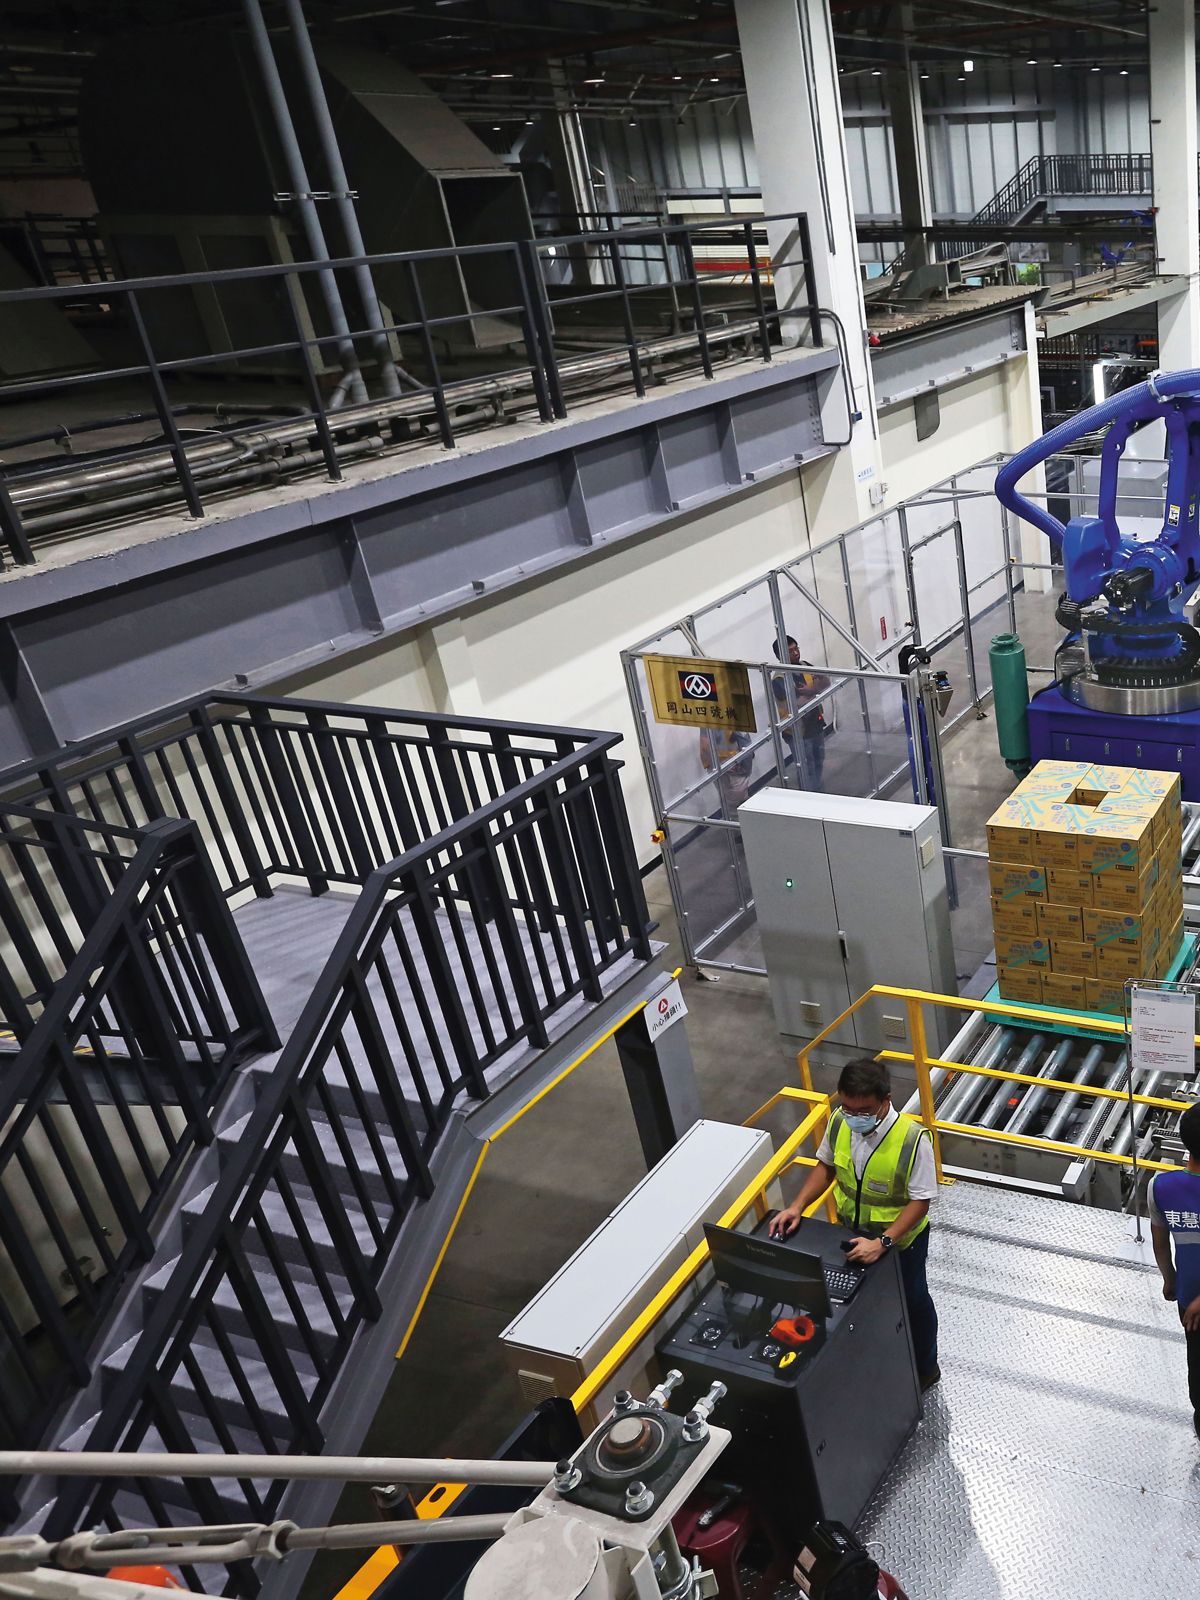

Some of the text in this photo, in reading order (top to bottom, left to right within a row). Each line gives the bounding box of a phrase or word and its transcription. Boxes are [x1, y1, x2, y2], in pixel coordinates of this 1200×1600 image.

[667, 702, 738, 720] 岡山四號機
